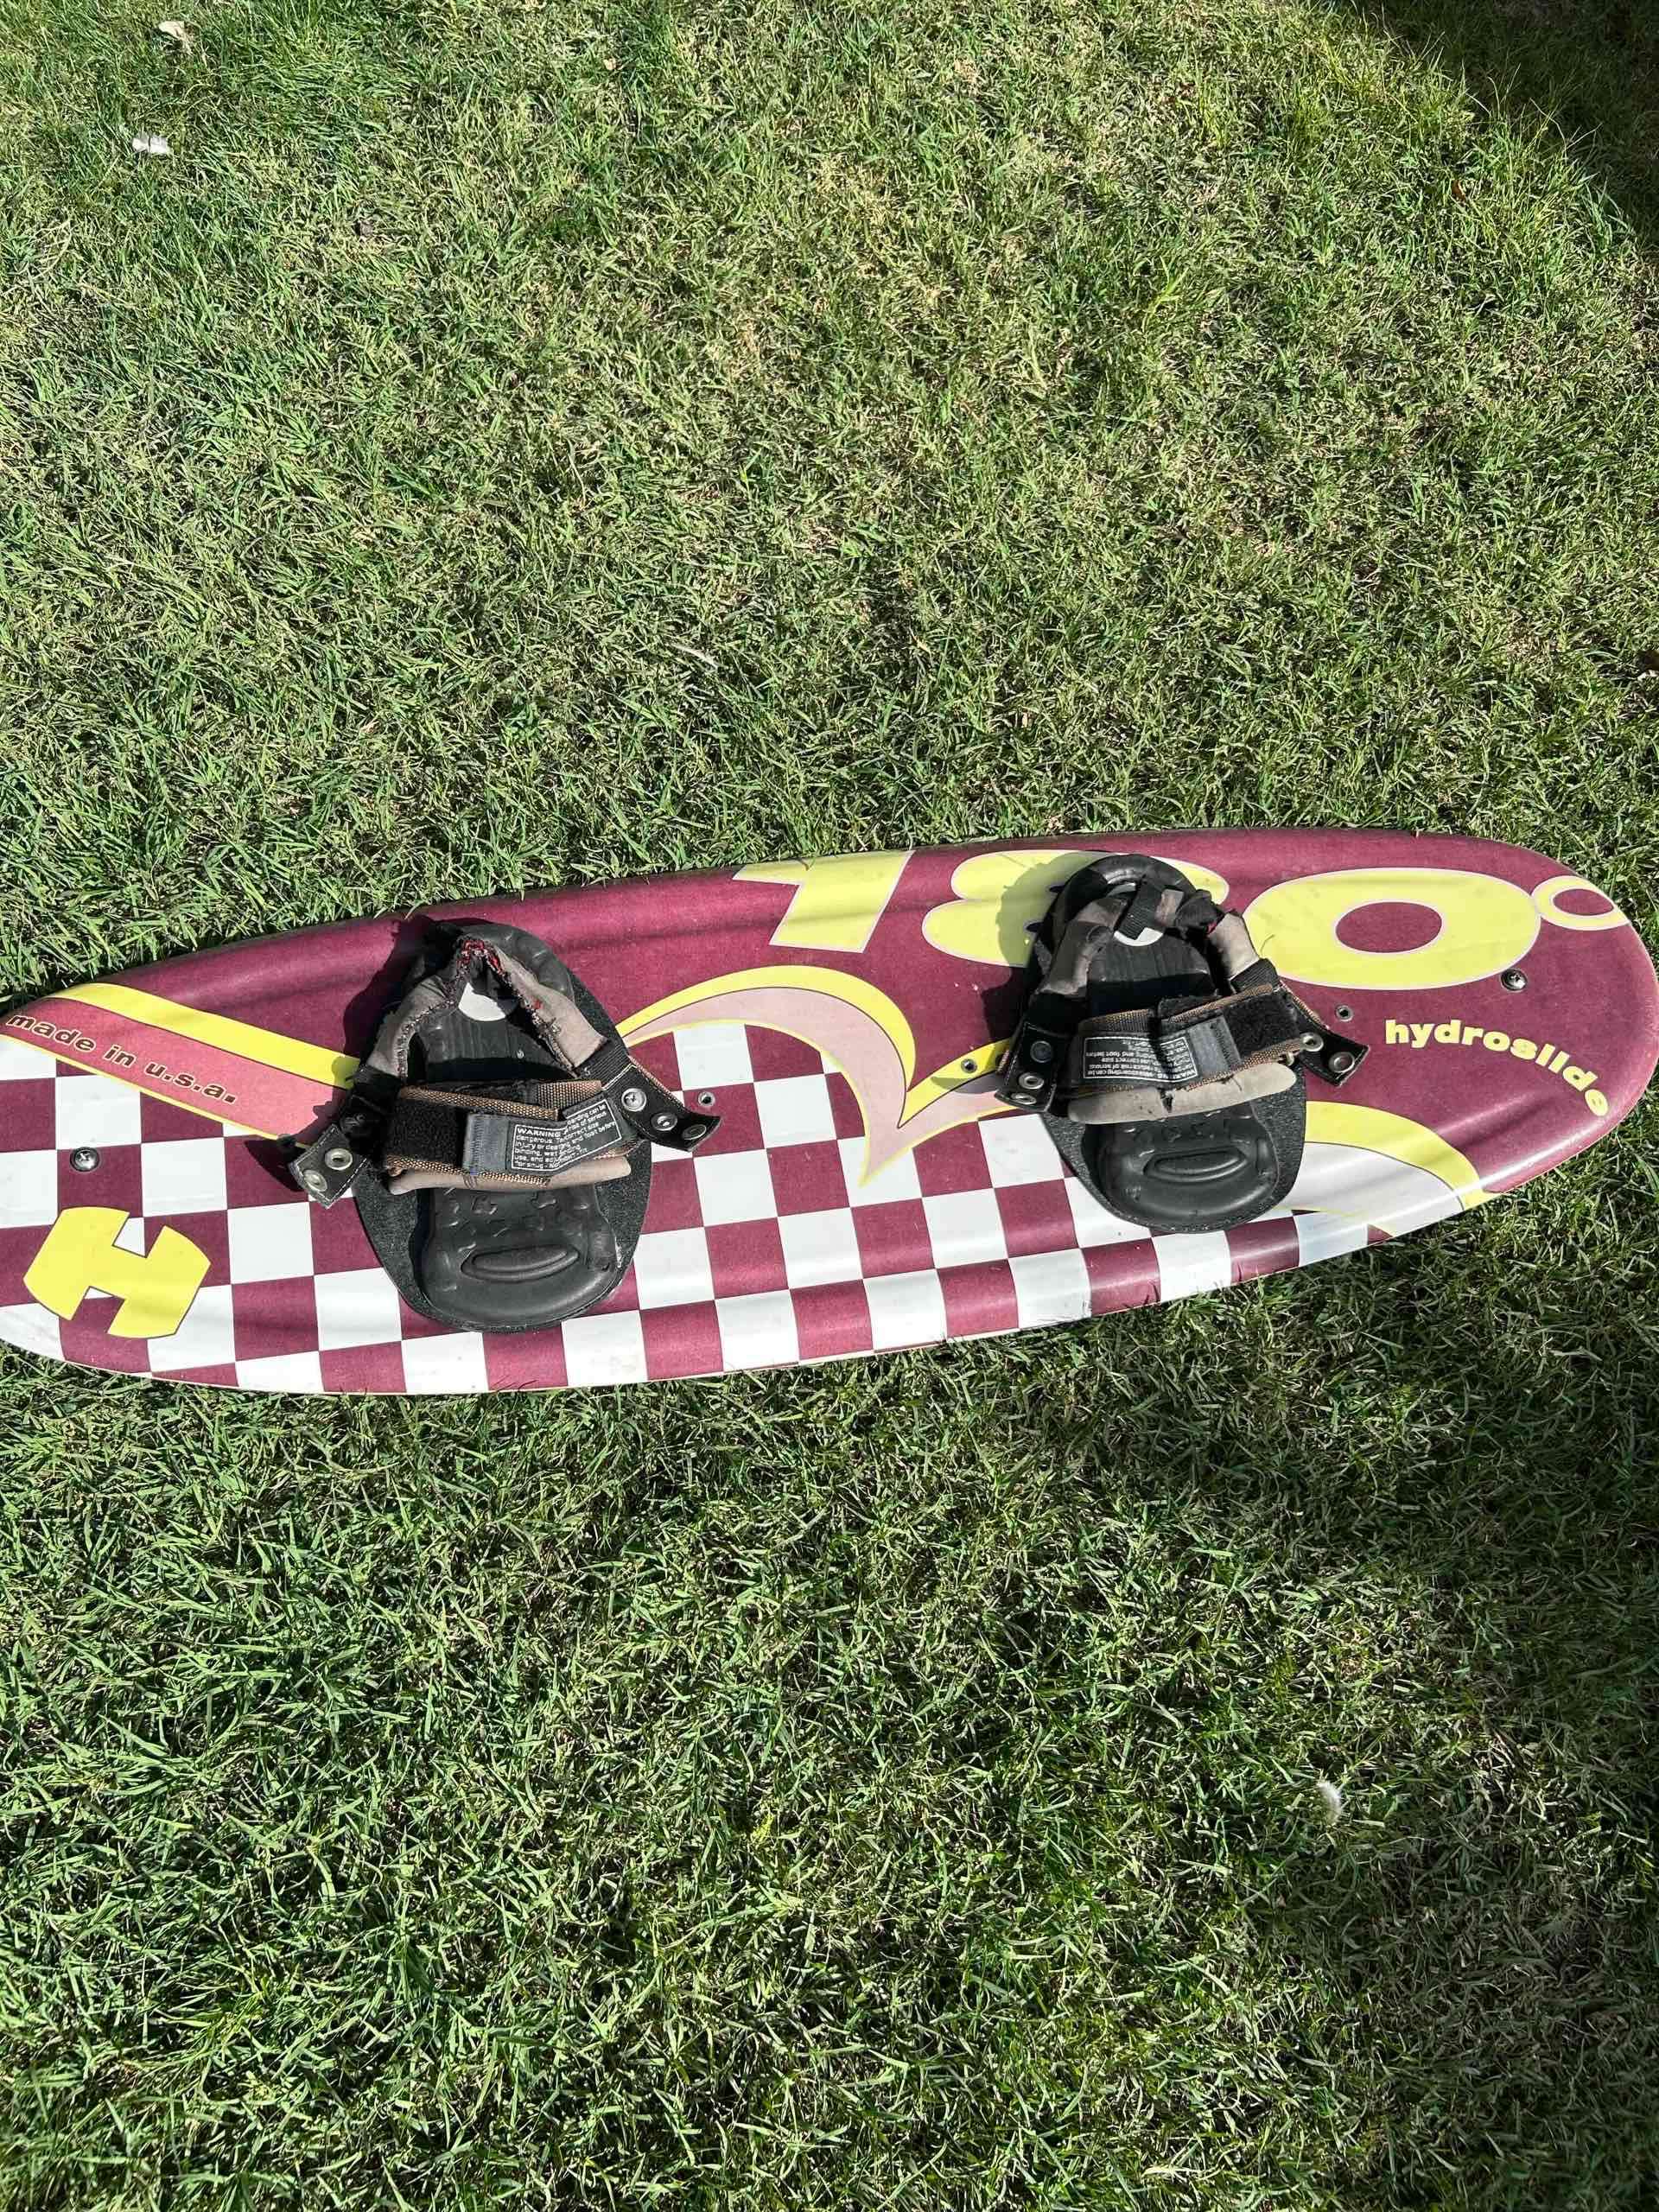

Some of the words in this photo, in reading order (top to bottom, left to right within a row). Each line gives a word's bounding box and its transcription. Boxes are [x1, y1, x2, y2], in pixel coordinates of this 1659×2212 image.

[6, 1014, 96, 1052] made
[102, 1044, 138, 1068] in
[143, 1061, 237, 1105] u.s.a.
